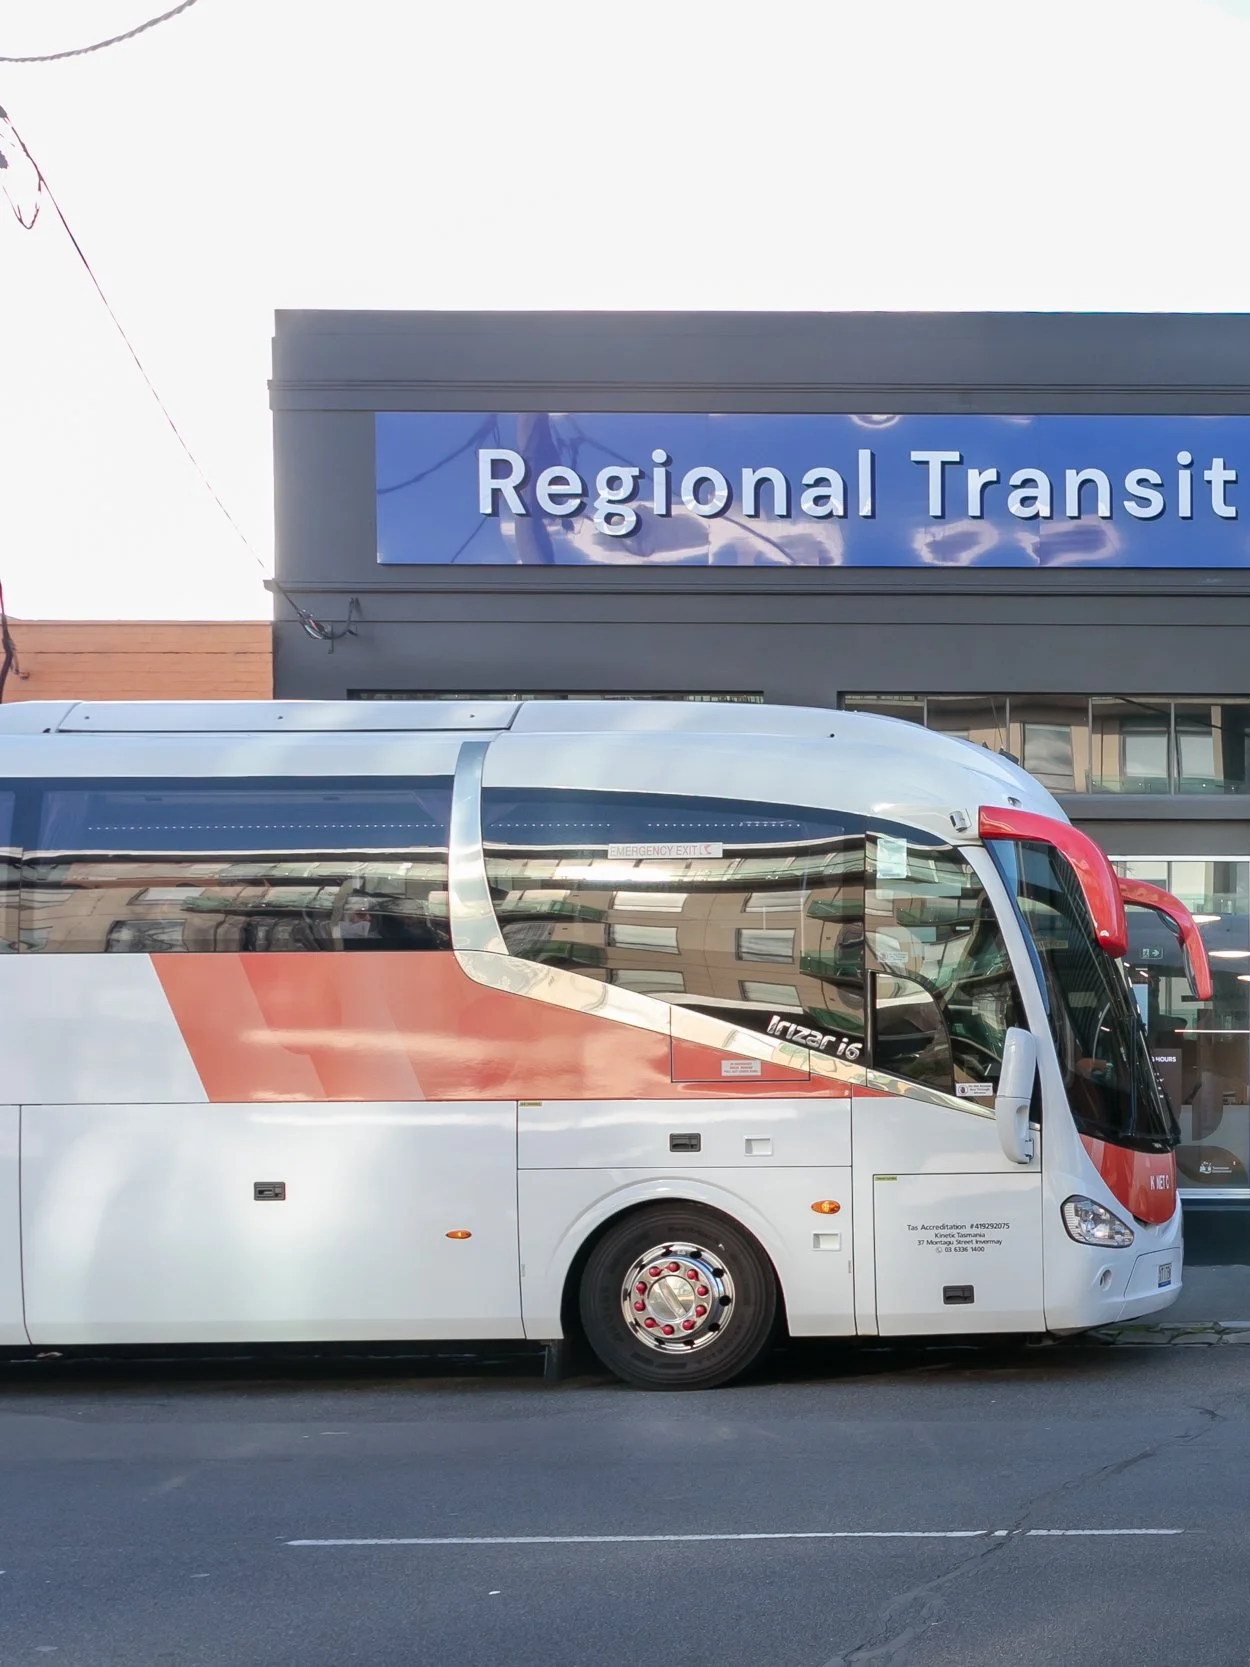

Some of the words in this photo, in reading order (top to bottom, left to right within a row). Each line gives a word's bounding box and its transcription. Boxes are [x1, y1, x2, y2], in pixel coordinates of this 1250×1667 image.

[478, 448, 877, 537] Regional
[909, 449, 1239, 521] Transit
[610, 845, 673, 857] EMERGENCY
[676, 845, 698, 855] EXIT
[767, 1015, 836, 1049] Irizar
[836, 1037, 862, 1060] i6
[920, 1223, 967, 1231] Accreditation
[969, 1222, 1010, 1230] #419292075
